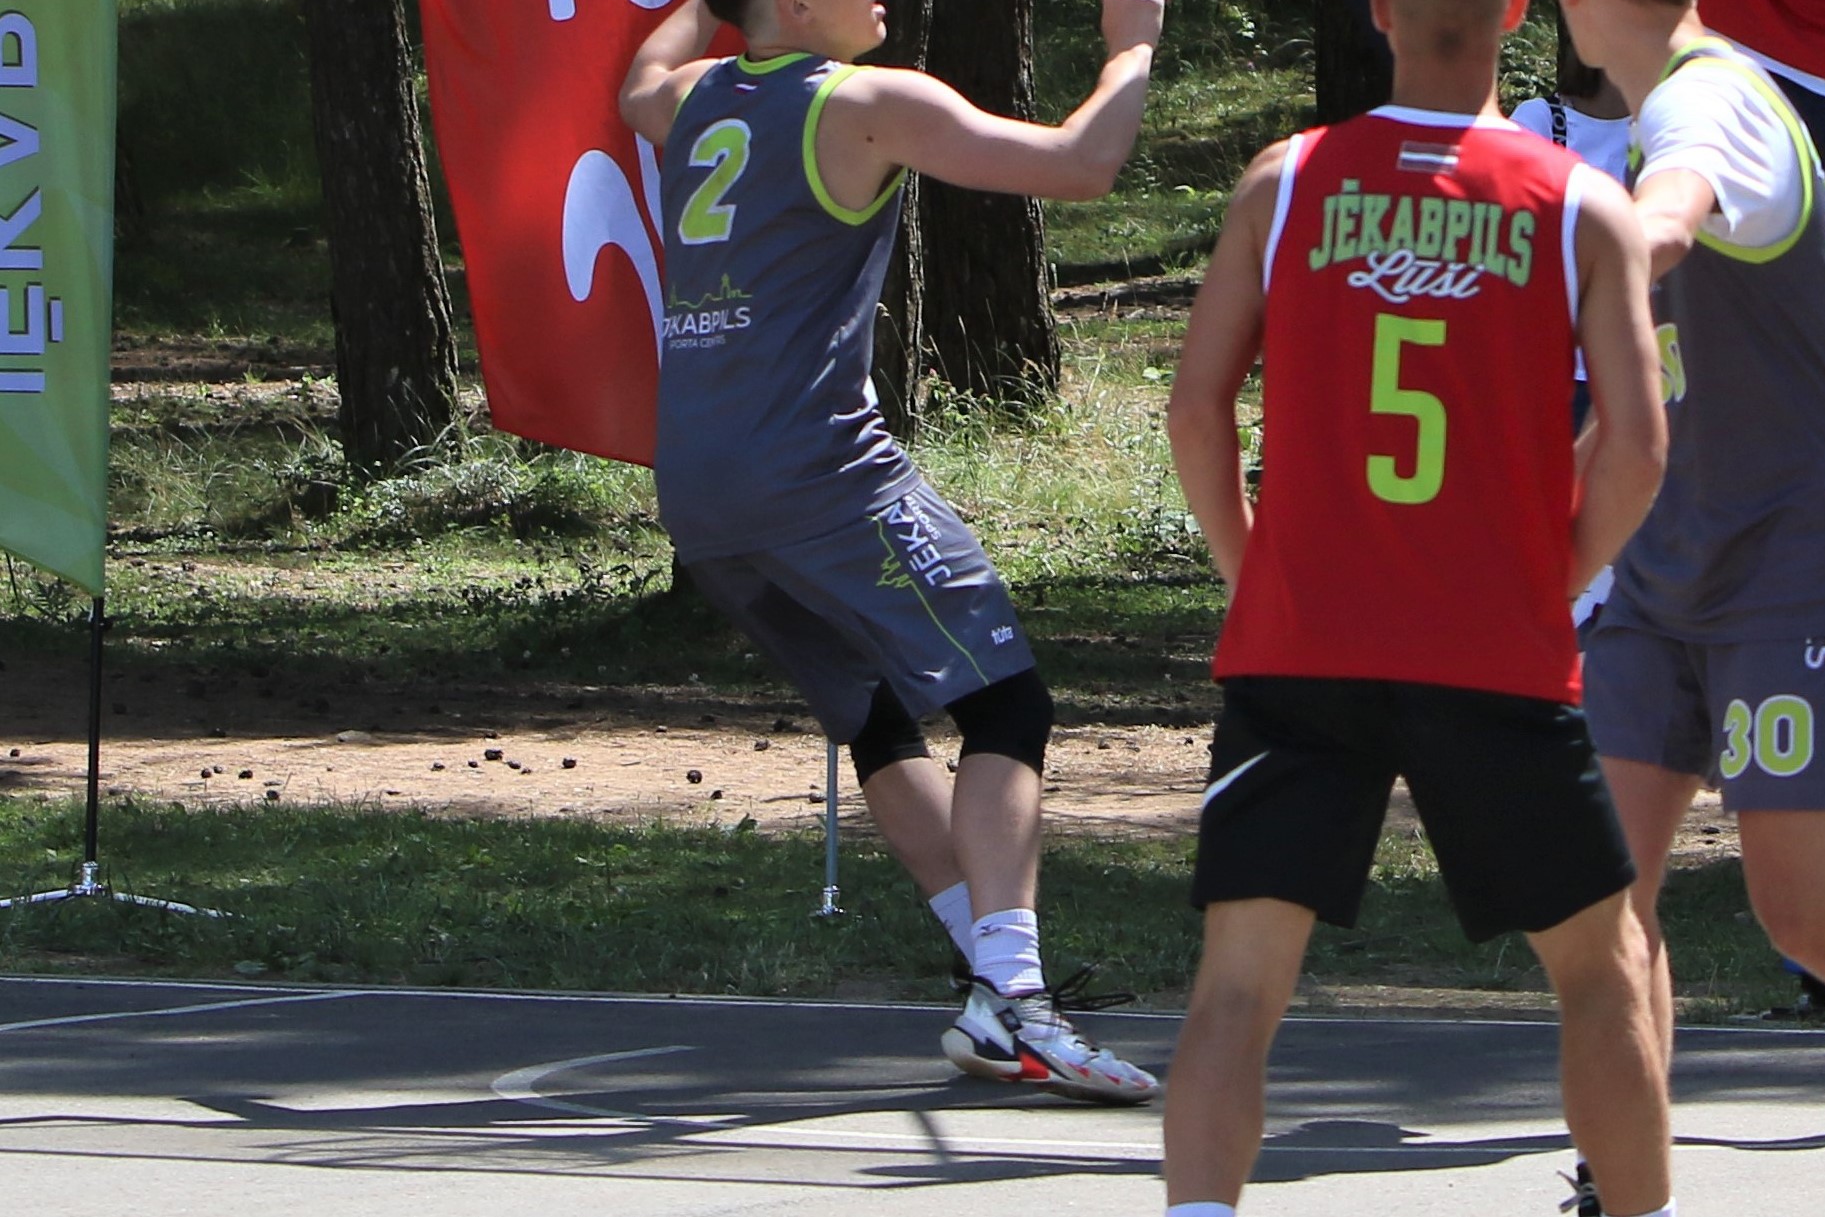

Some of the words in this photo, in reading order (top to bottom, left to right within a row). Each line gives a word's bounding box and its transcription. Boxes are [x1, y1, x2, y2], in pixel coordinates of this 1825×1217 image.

[677, 117, 752, 245] 2
[1308, 178, 1535, 288] JĒKABPILS
[1366, 313, 1447, 504] 5
[1719, 694, 1814, 780] 30
